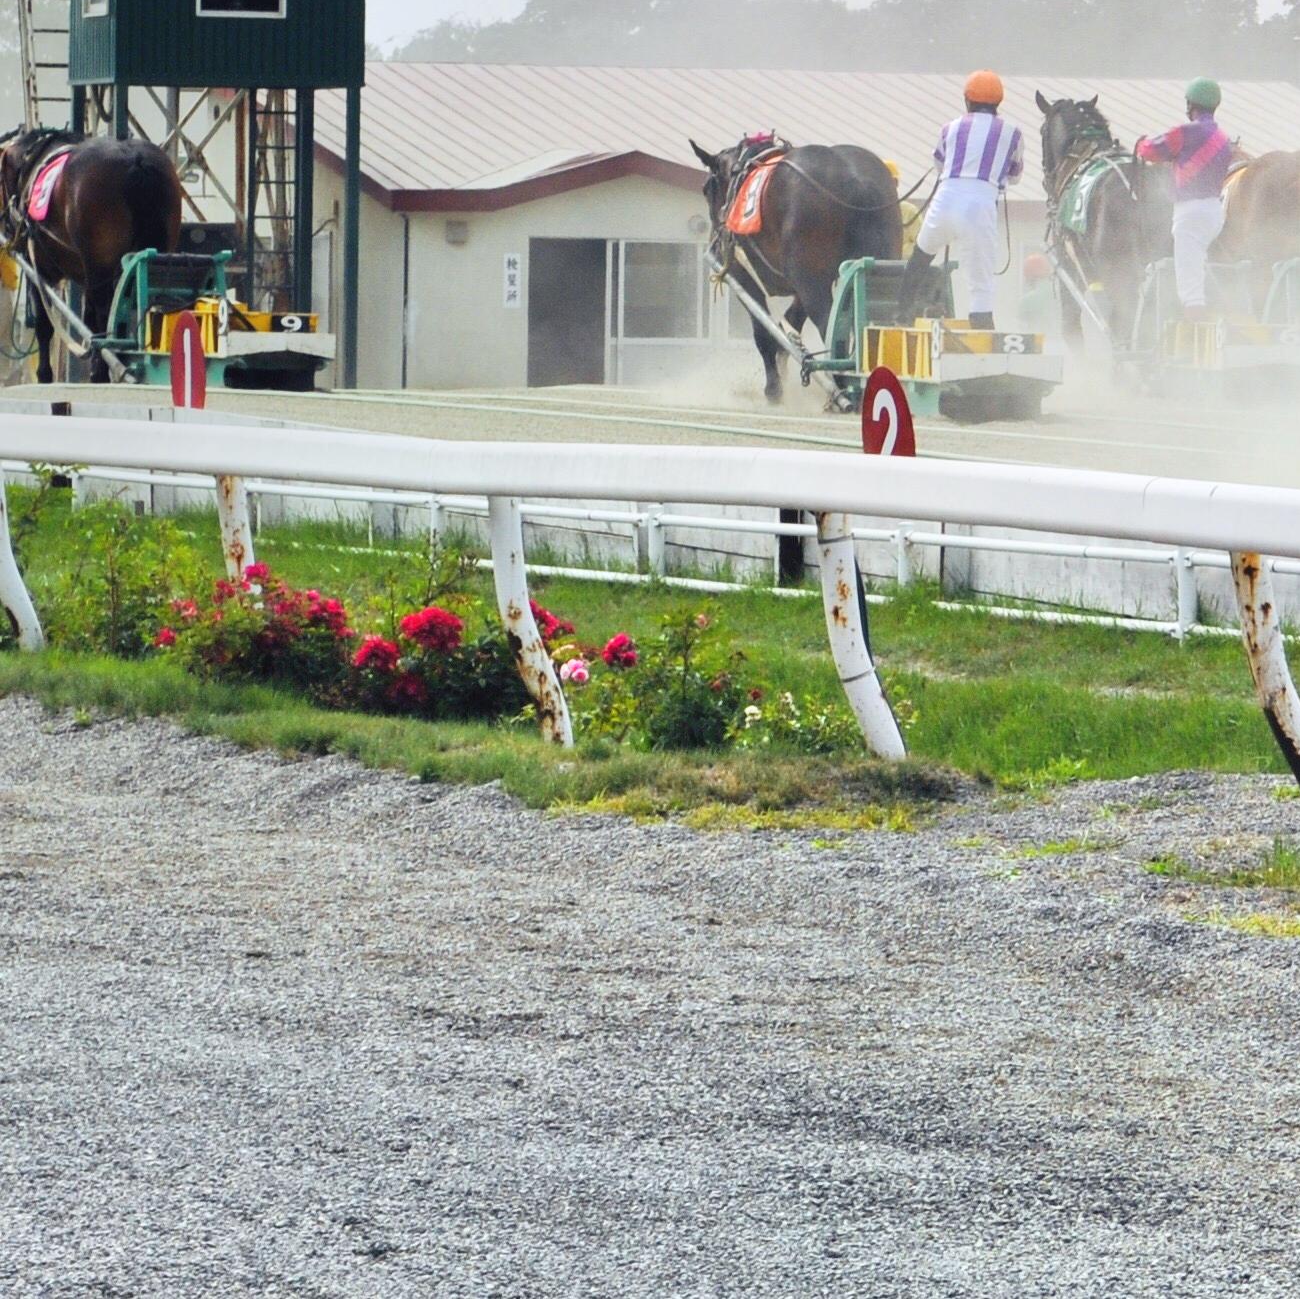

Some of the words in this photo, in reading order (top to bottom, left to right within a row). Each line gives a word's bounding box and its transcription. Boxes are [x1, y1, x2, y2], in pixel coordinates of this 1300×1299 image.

[218, 299, 229, 335] 9
[281, 315, 302, 333] 9
[1003, 334, 1025, 354] 8
